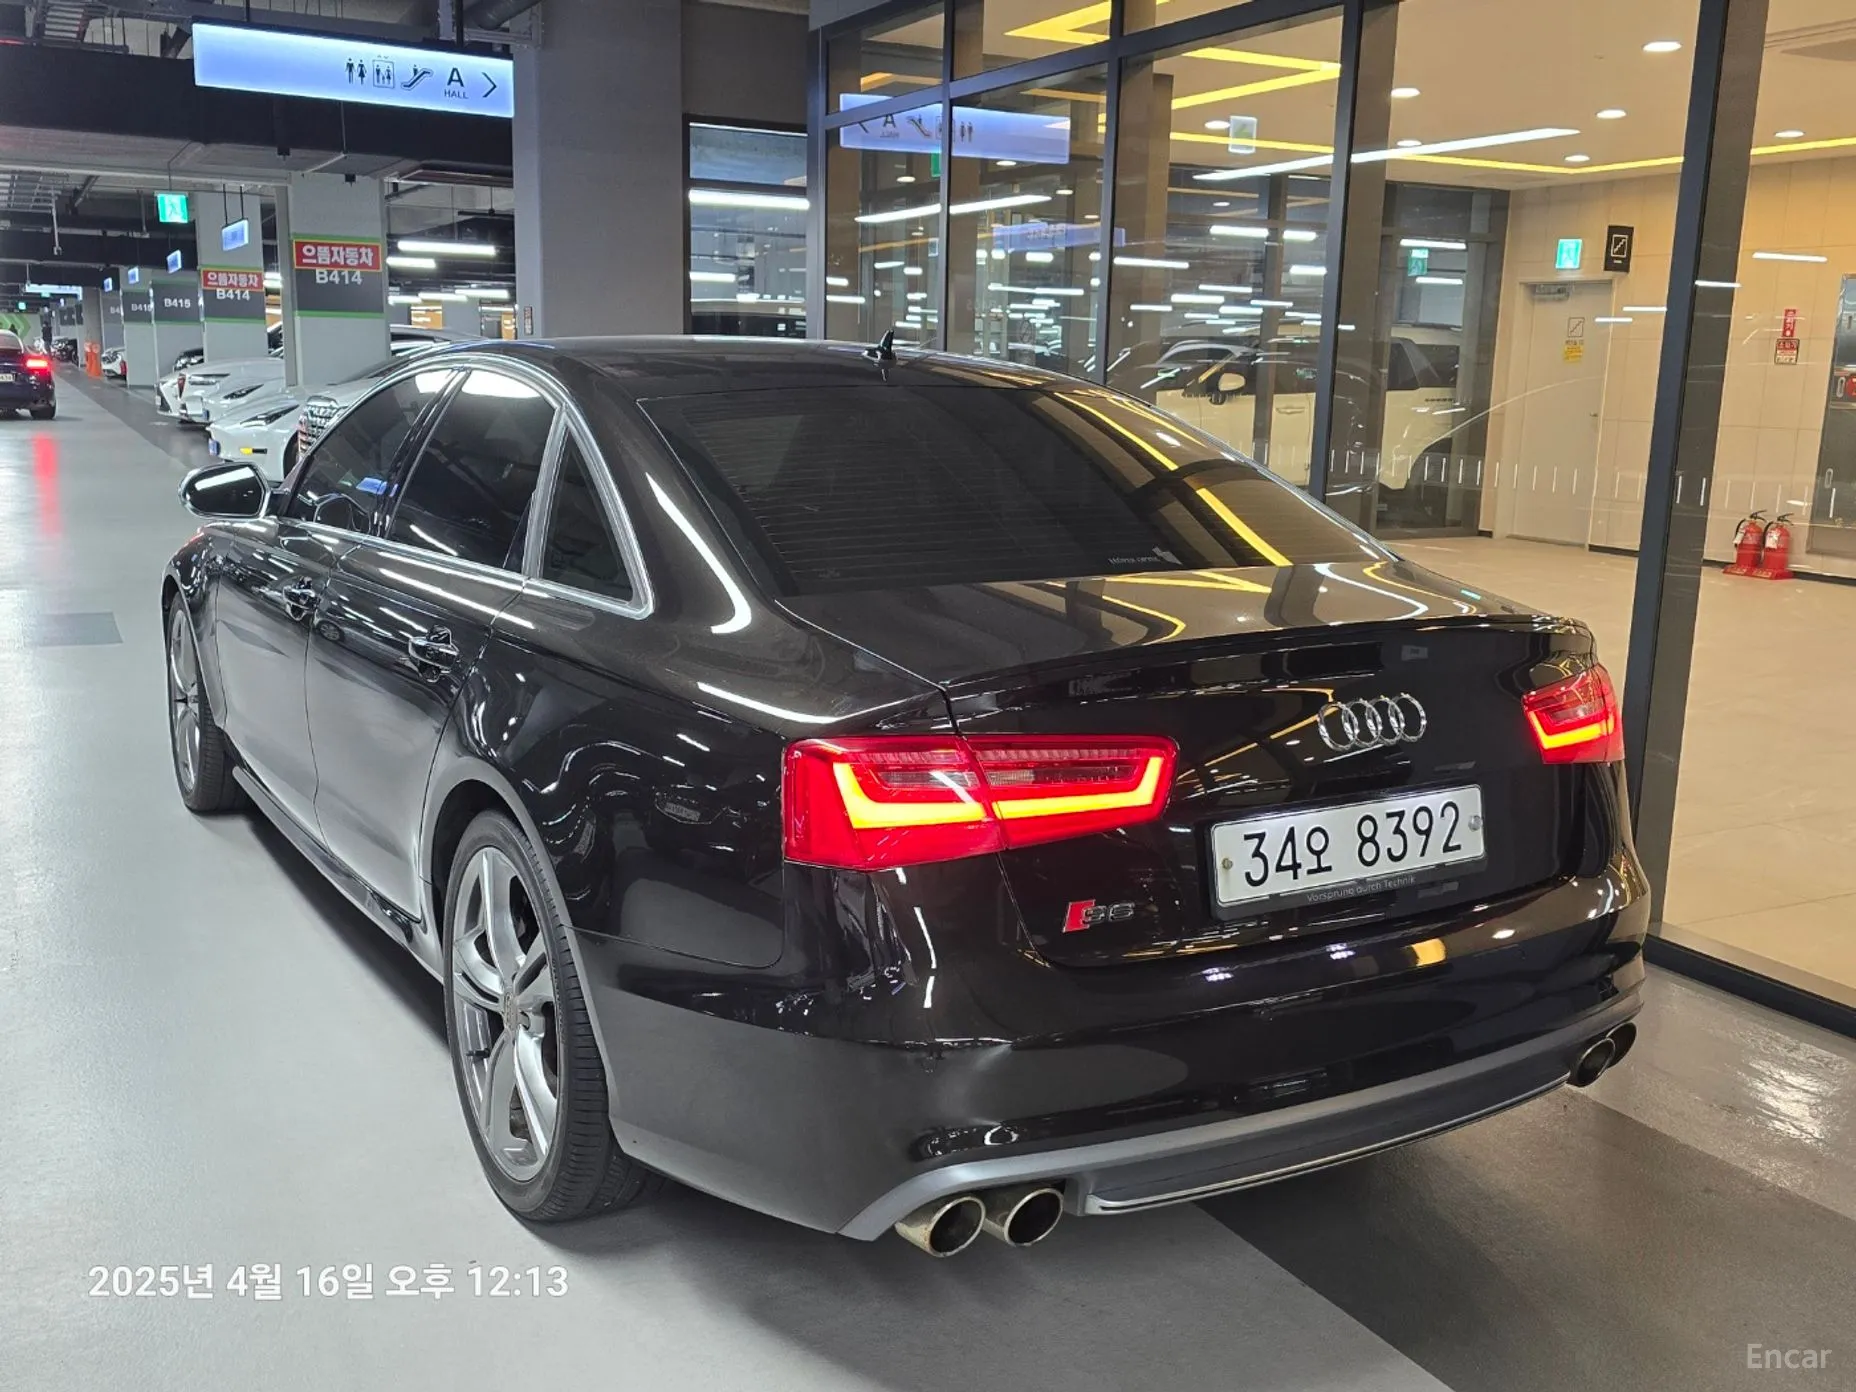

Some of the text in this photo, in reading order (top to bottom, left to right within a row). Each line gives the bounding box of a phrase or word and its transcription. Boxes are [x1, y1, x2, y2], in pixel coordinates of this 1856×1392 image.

[447, 67, 464, 87] A
[444, 89, 469, 99] HALL
[302, 244, 374, 267] 으뜸자동차
[207, 271, 259, 288] 으뜸자동차
[315, 268, 362, 285] B414
[216, 288, 250, 301] B414
[1243, 800, 1462, 887] 34오 8392
